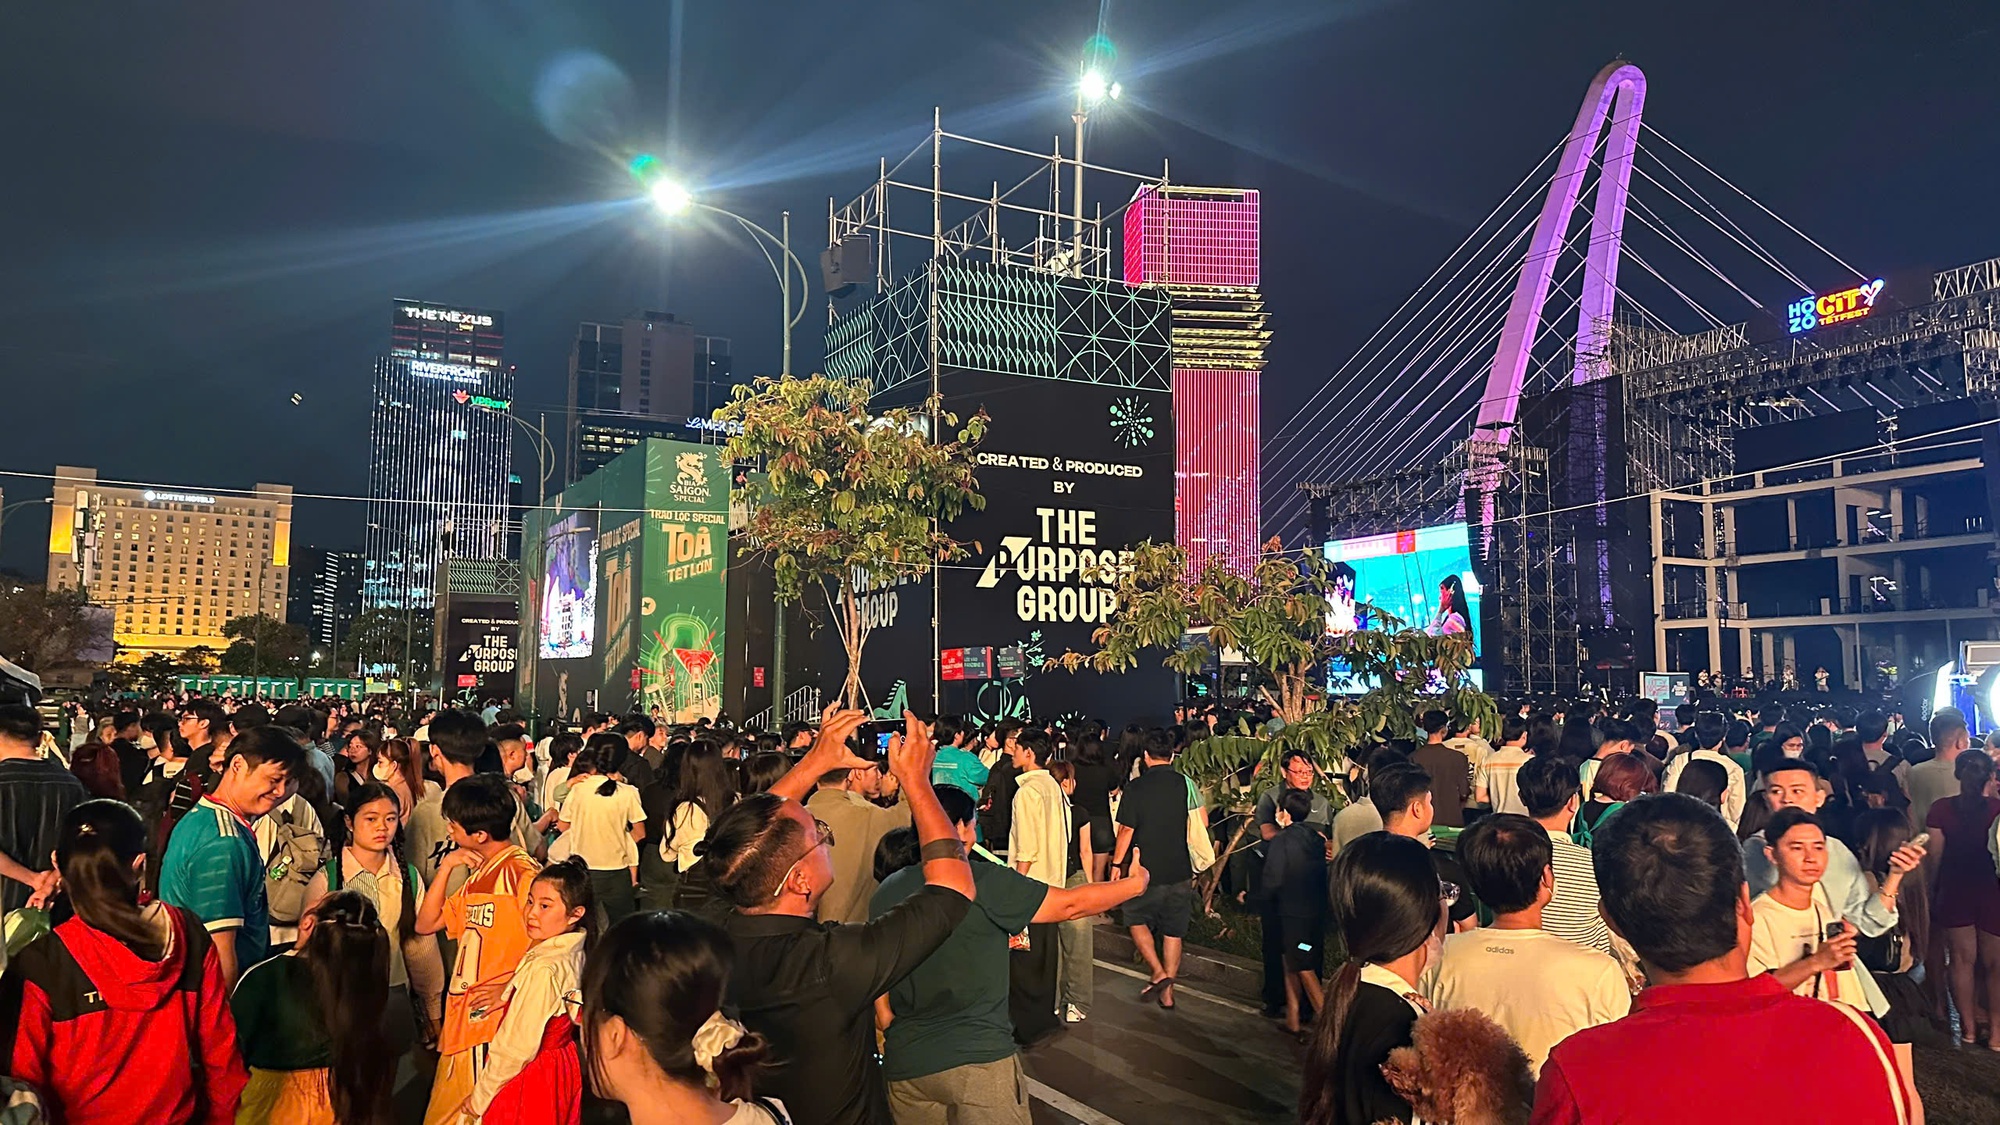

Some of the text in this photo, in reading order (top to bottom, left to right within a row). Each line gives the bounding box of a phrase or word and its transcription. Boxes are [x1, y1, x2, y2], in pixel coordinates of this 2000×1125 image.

[404, 307, 493, 326] THE NEXUS
[411, 360, 482, 380] RIVERFRONT
[470, 395, 512, 410] VPBank
[976, 452, 1143, 478] CREATED & PRODUCED
[669, 484, 710, 497] SAIGON
[1053, 481, 1075, 494] BY
[156, 493, 185, 502] LOTTE
[673, 494, 706, 504] SPECIAL
[692, 513, 725, 525] SPECIAL
[1036, 507, 1097, 546] THE
[1016, 585, 1117, 623] GROUP
[483, 635, 508, 648] THE
[458, 644, 518, 662] PURPOS
[473, 660, 515, 673] GROUP
[1485, 946, 1515, 955] adidas
